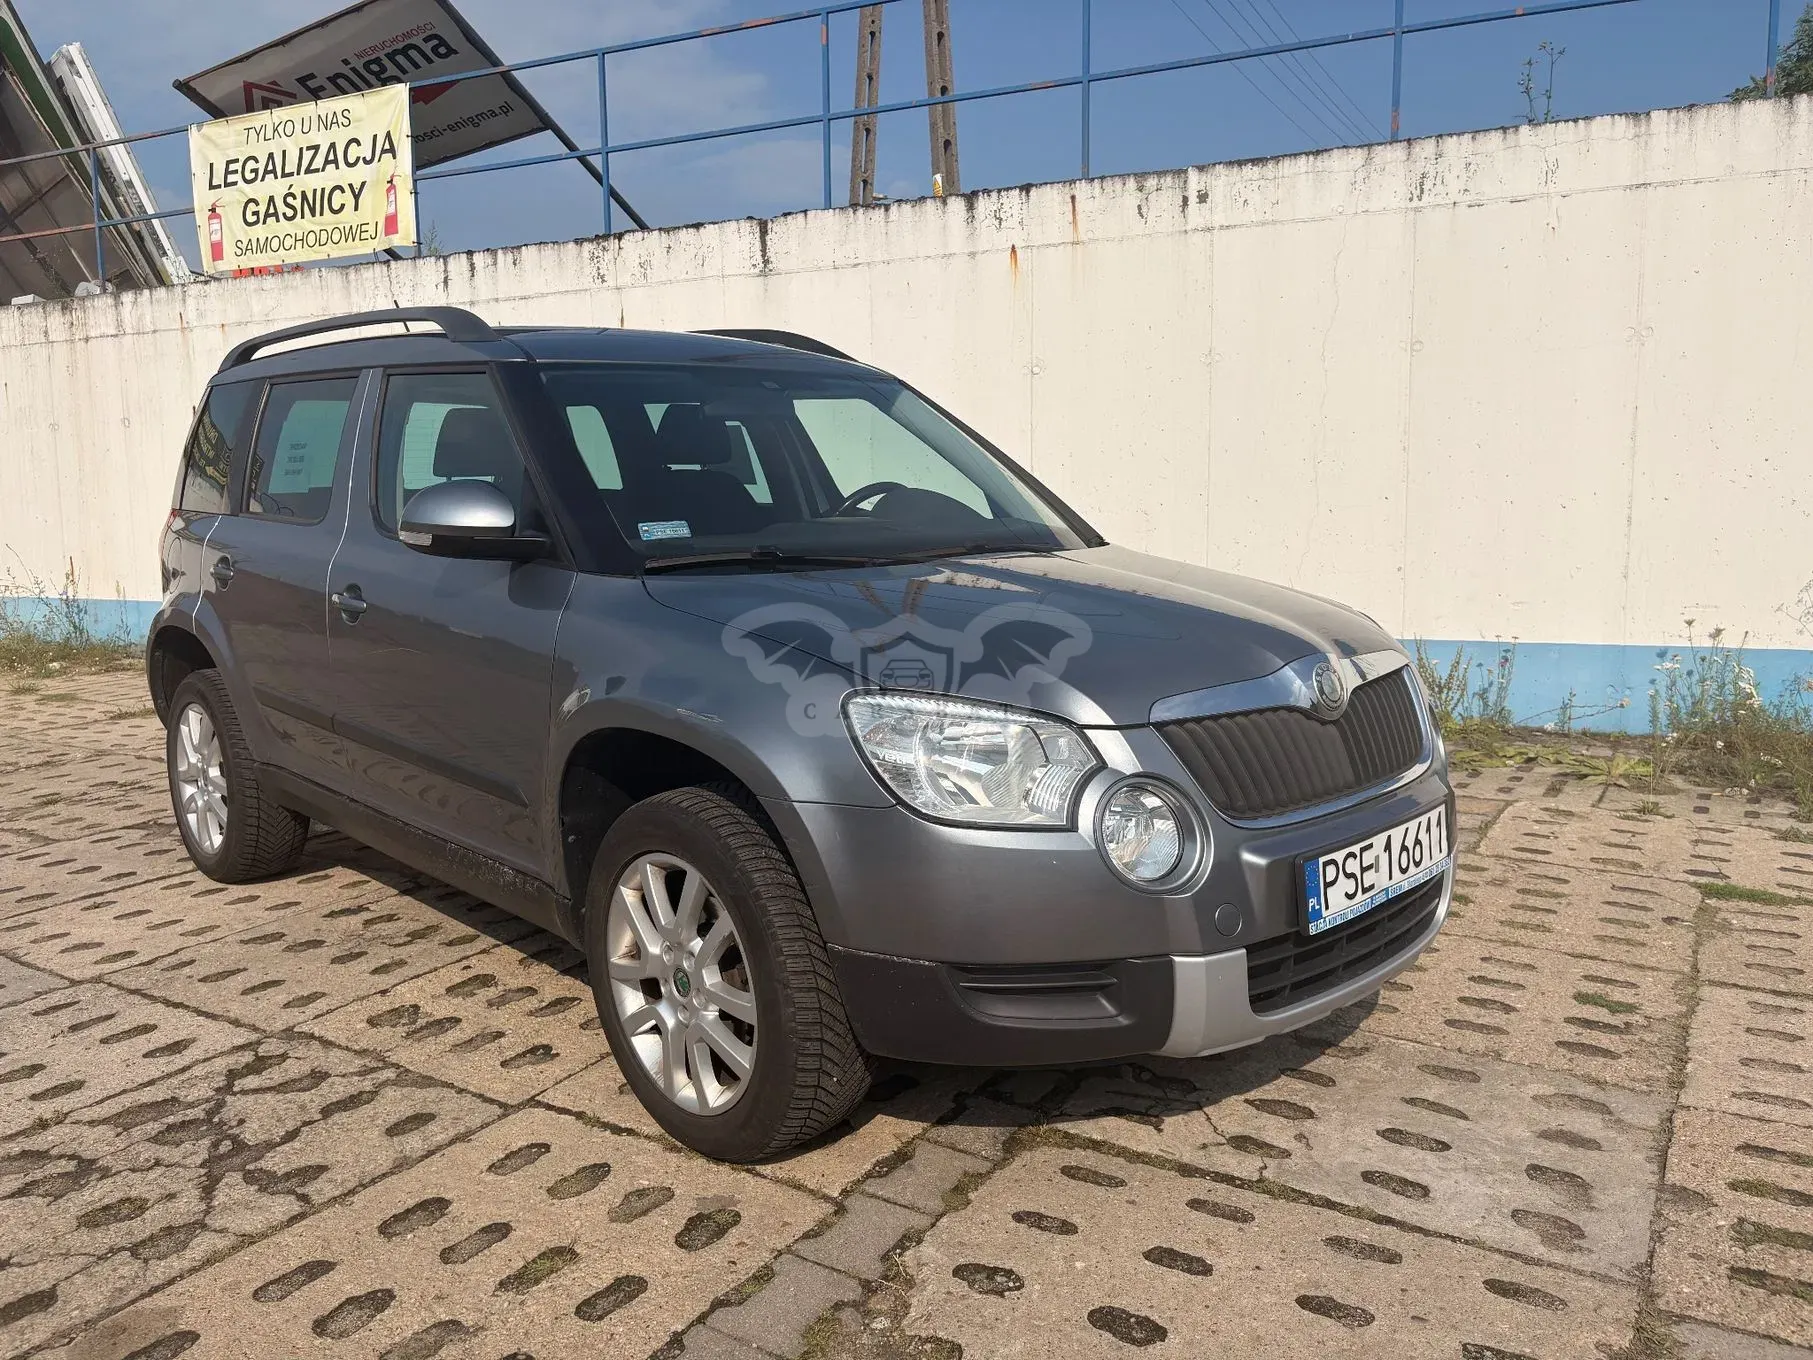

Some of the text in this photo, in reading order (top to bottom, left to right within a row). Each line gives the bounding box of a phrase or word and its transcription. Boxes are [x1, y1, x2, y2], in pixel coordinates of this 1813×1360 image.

[354, 21, 436, 60] NIERUCHOMOŚCI
[294, 33, 460, 100] Enigma
[243, 108, 352, 144] TYLKO U NAS
[208, 130, 397, 190] LEGALIZACJA
[242, 180, 367, 227] GAŚNICY
[234, 221, 379, 257] SAMOCHODOWEJ
[1308, 897, 1320, 912] PL
